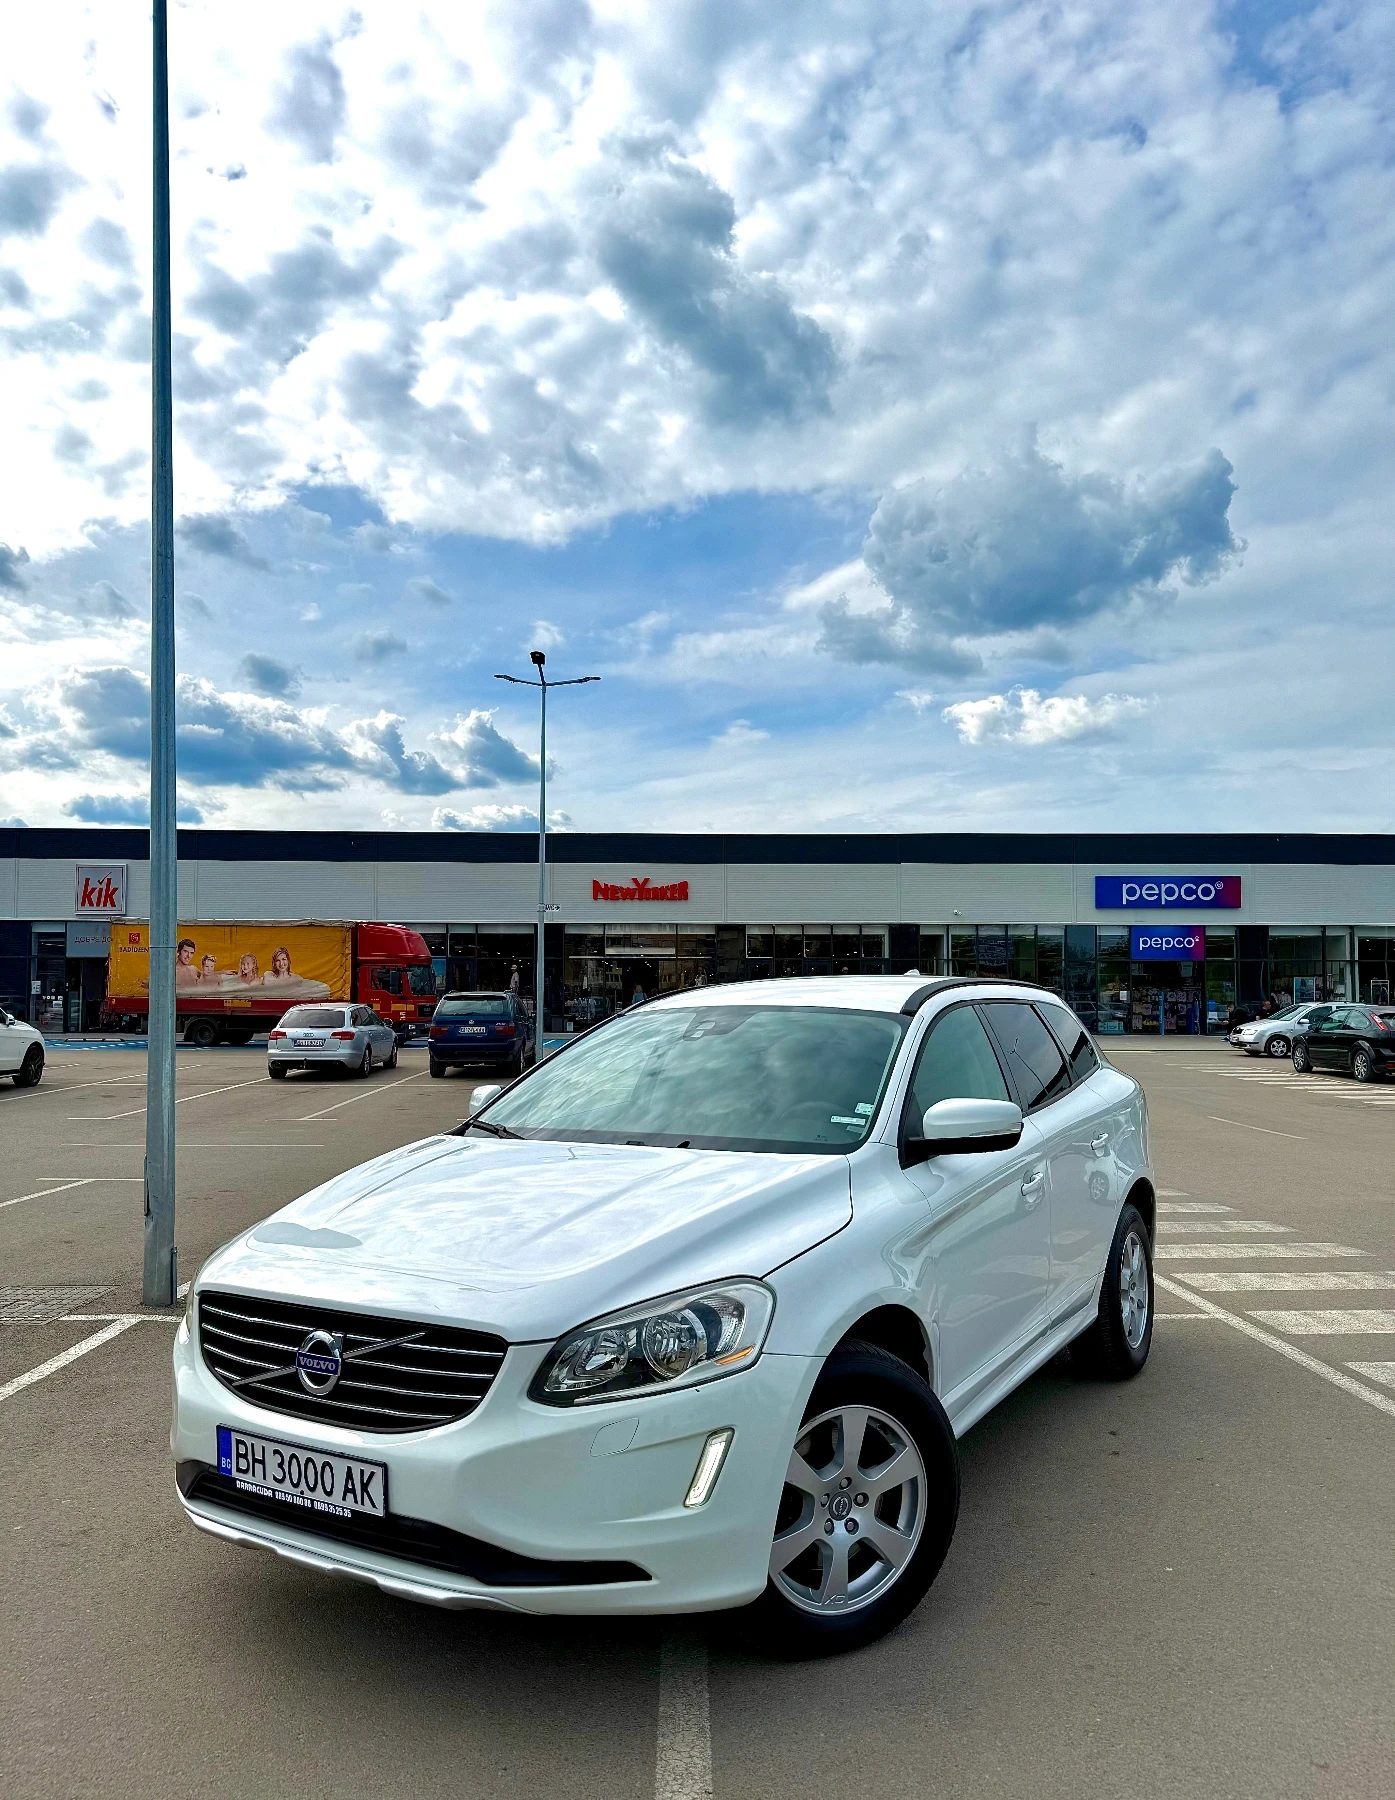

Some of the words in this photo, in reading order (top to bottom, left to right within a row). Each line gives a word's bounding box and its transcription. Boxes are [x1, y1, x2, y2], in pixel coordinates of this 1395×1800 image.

[81, 872, 119, 908] kik
[1139, 936, 1195, 951] pepco
[299, 1356, 336, 1371] VOLVO
[221, 1456, 232, 1469] BG
[234, 1437, 267, 1481] BH
[272, 1448, 336, 1498] 3000
[342, 1465, 378, 1509] AK
